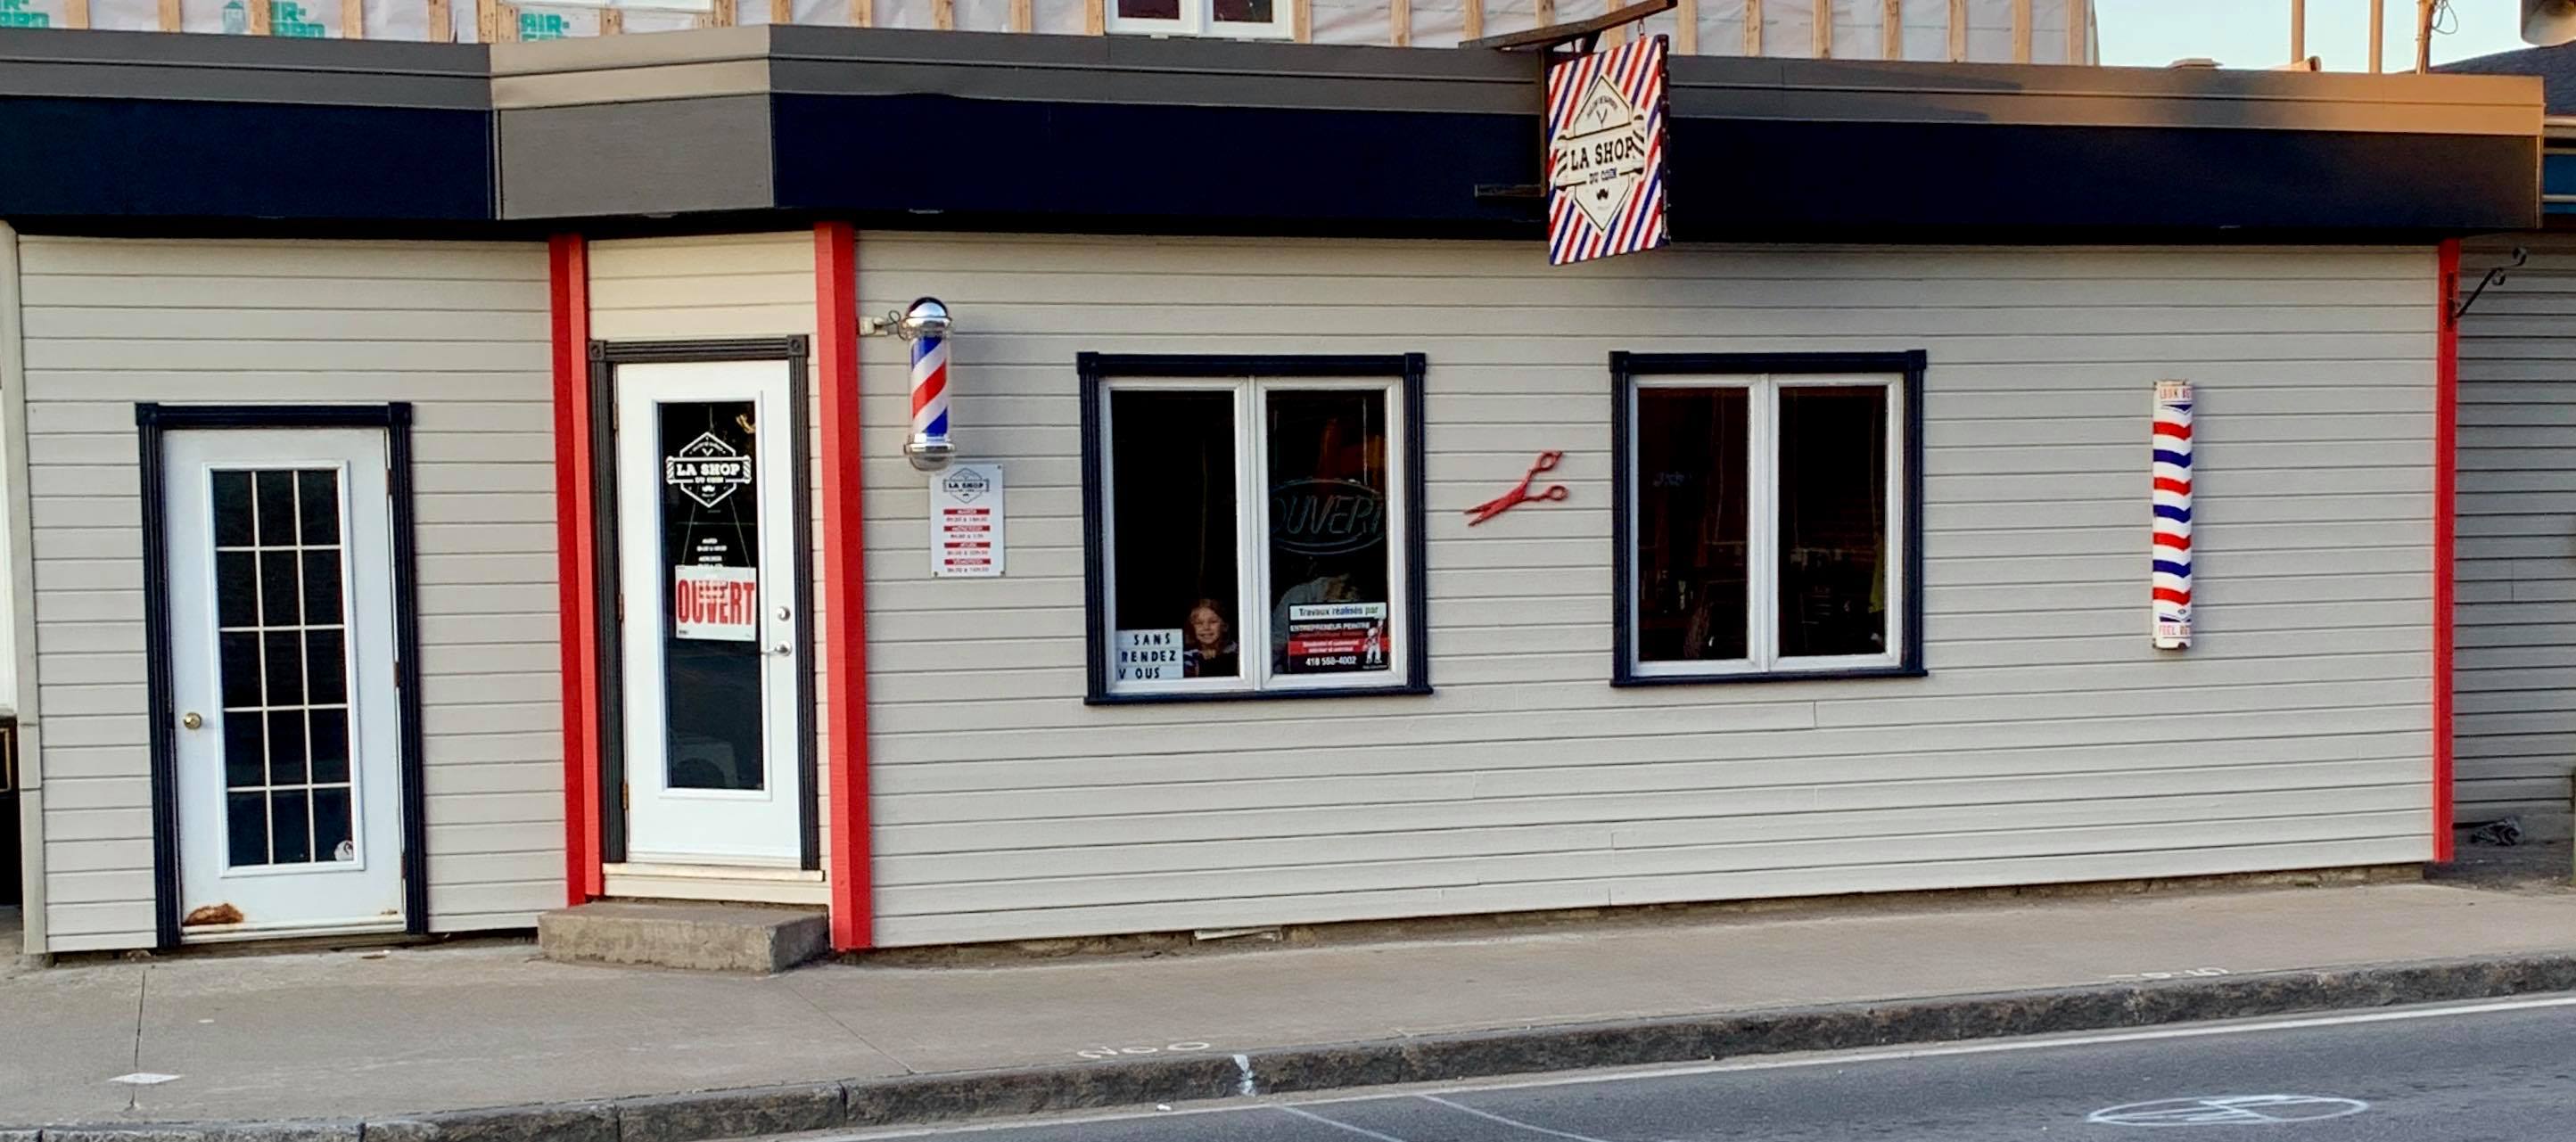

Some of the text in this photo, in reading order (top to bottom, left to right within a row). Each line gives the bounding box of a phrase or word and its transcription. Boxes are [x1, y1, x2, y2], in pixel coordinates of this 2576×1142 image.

[1570, 136, 1634, 171] LA SHOP
[676, 463, 741, 476] LA SHOP
[678, 579, 755, 626] OUVERT
[1299, 606, 1329, 617] Travaux
[1365, 605, 1379, 615] par
[1134, 632, 1171, 645] SANS
[1122, 650, 1176, 662] RENDEZ
